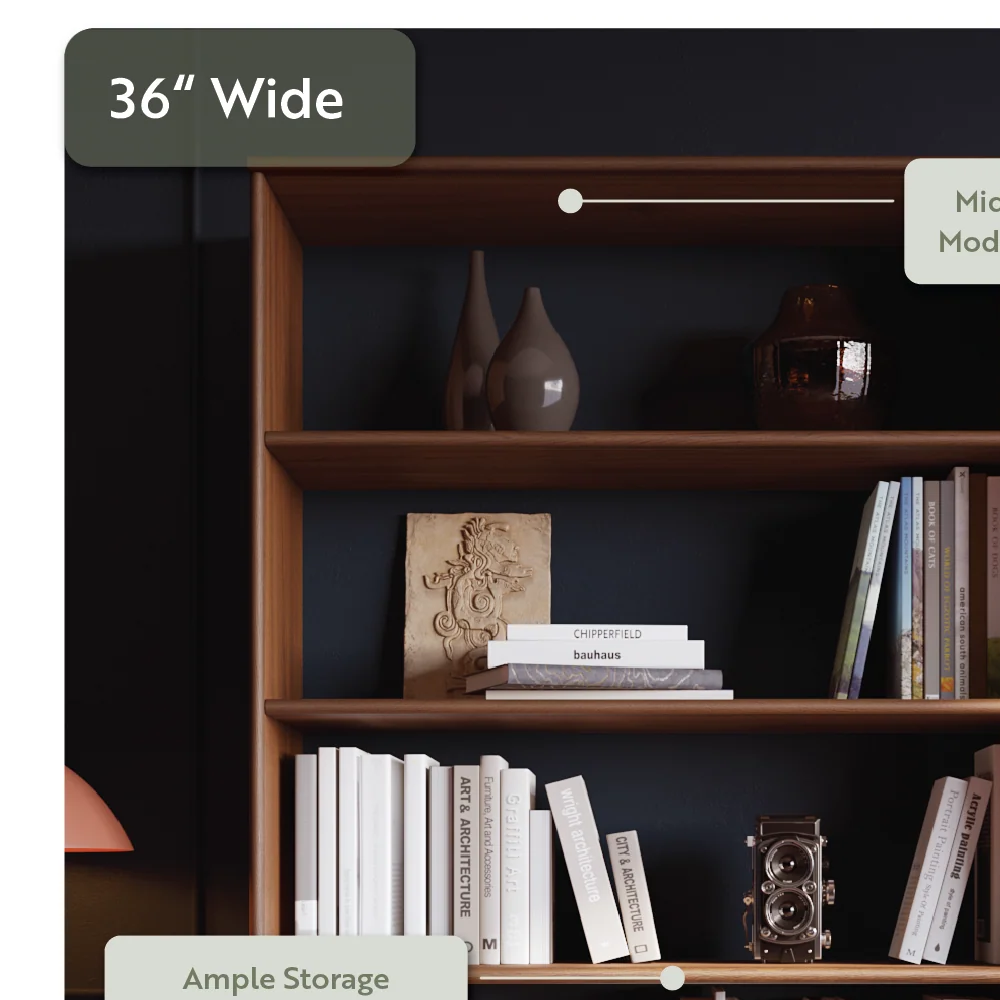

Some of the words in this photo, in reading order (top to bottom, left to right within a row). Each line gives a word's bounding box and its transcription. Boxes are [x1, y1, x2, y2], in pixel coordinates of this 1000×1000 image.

[927, 501, 936, 527] BOOK
[991, 507, 999, 533] BOOK
[927, 532, 936, 541] OF
[927, 546, 936, 569] CATS
[991, 552, 999, 579] DOGS
[573, 629, 642, 639] CHIPPERFIELD
[573, 649, 622, 660] bauhaus
[460, 776, 471, 803] ART
[460, 803, 471, 814] &
[561, 787, 582, 829] wright
[941, 789, 960, 833] Portrait
[964, 792, 982, 830] Acrylic
[483, 817, 493, 830] Art
[505, 793, 521, 860] Graffiti
[483, 830, 493, 847] and
[615, 836, 630, 856] CITY
[460, 817, 471, 918] ARCHITECTURE
[571, 829, 600, 903] architecture
[619, 857, 630, 866] &
[923, 836, 948, 881] Painting
[950, 832, 970, 880] painting
[505, 866, 521, 893] Art
[622, 867, 645, 933] ARCHITECTURE
[482, 938, 497, 950] M
